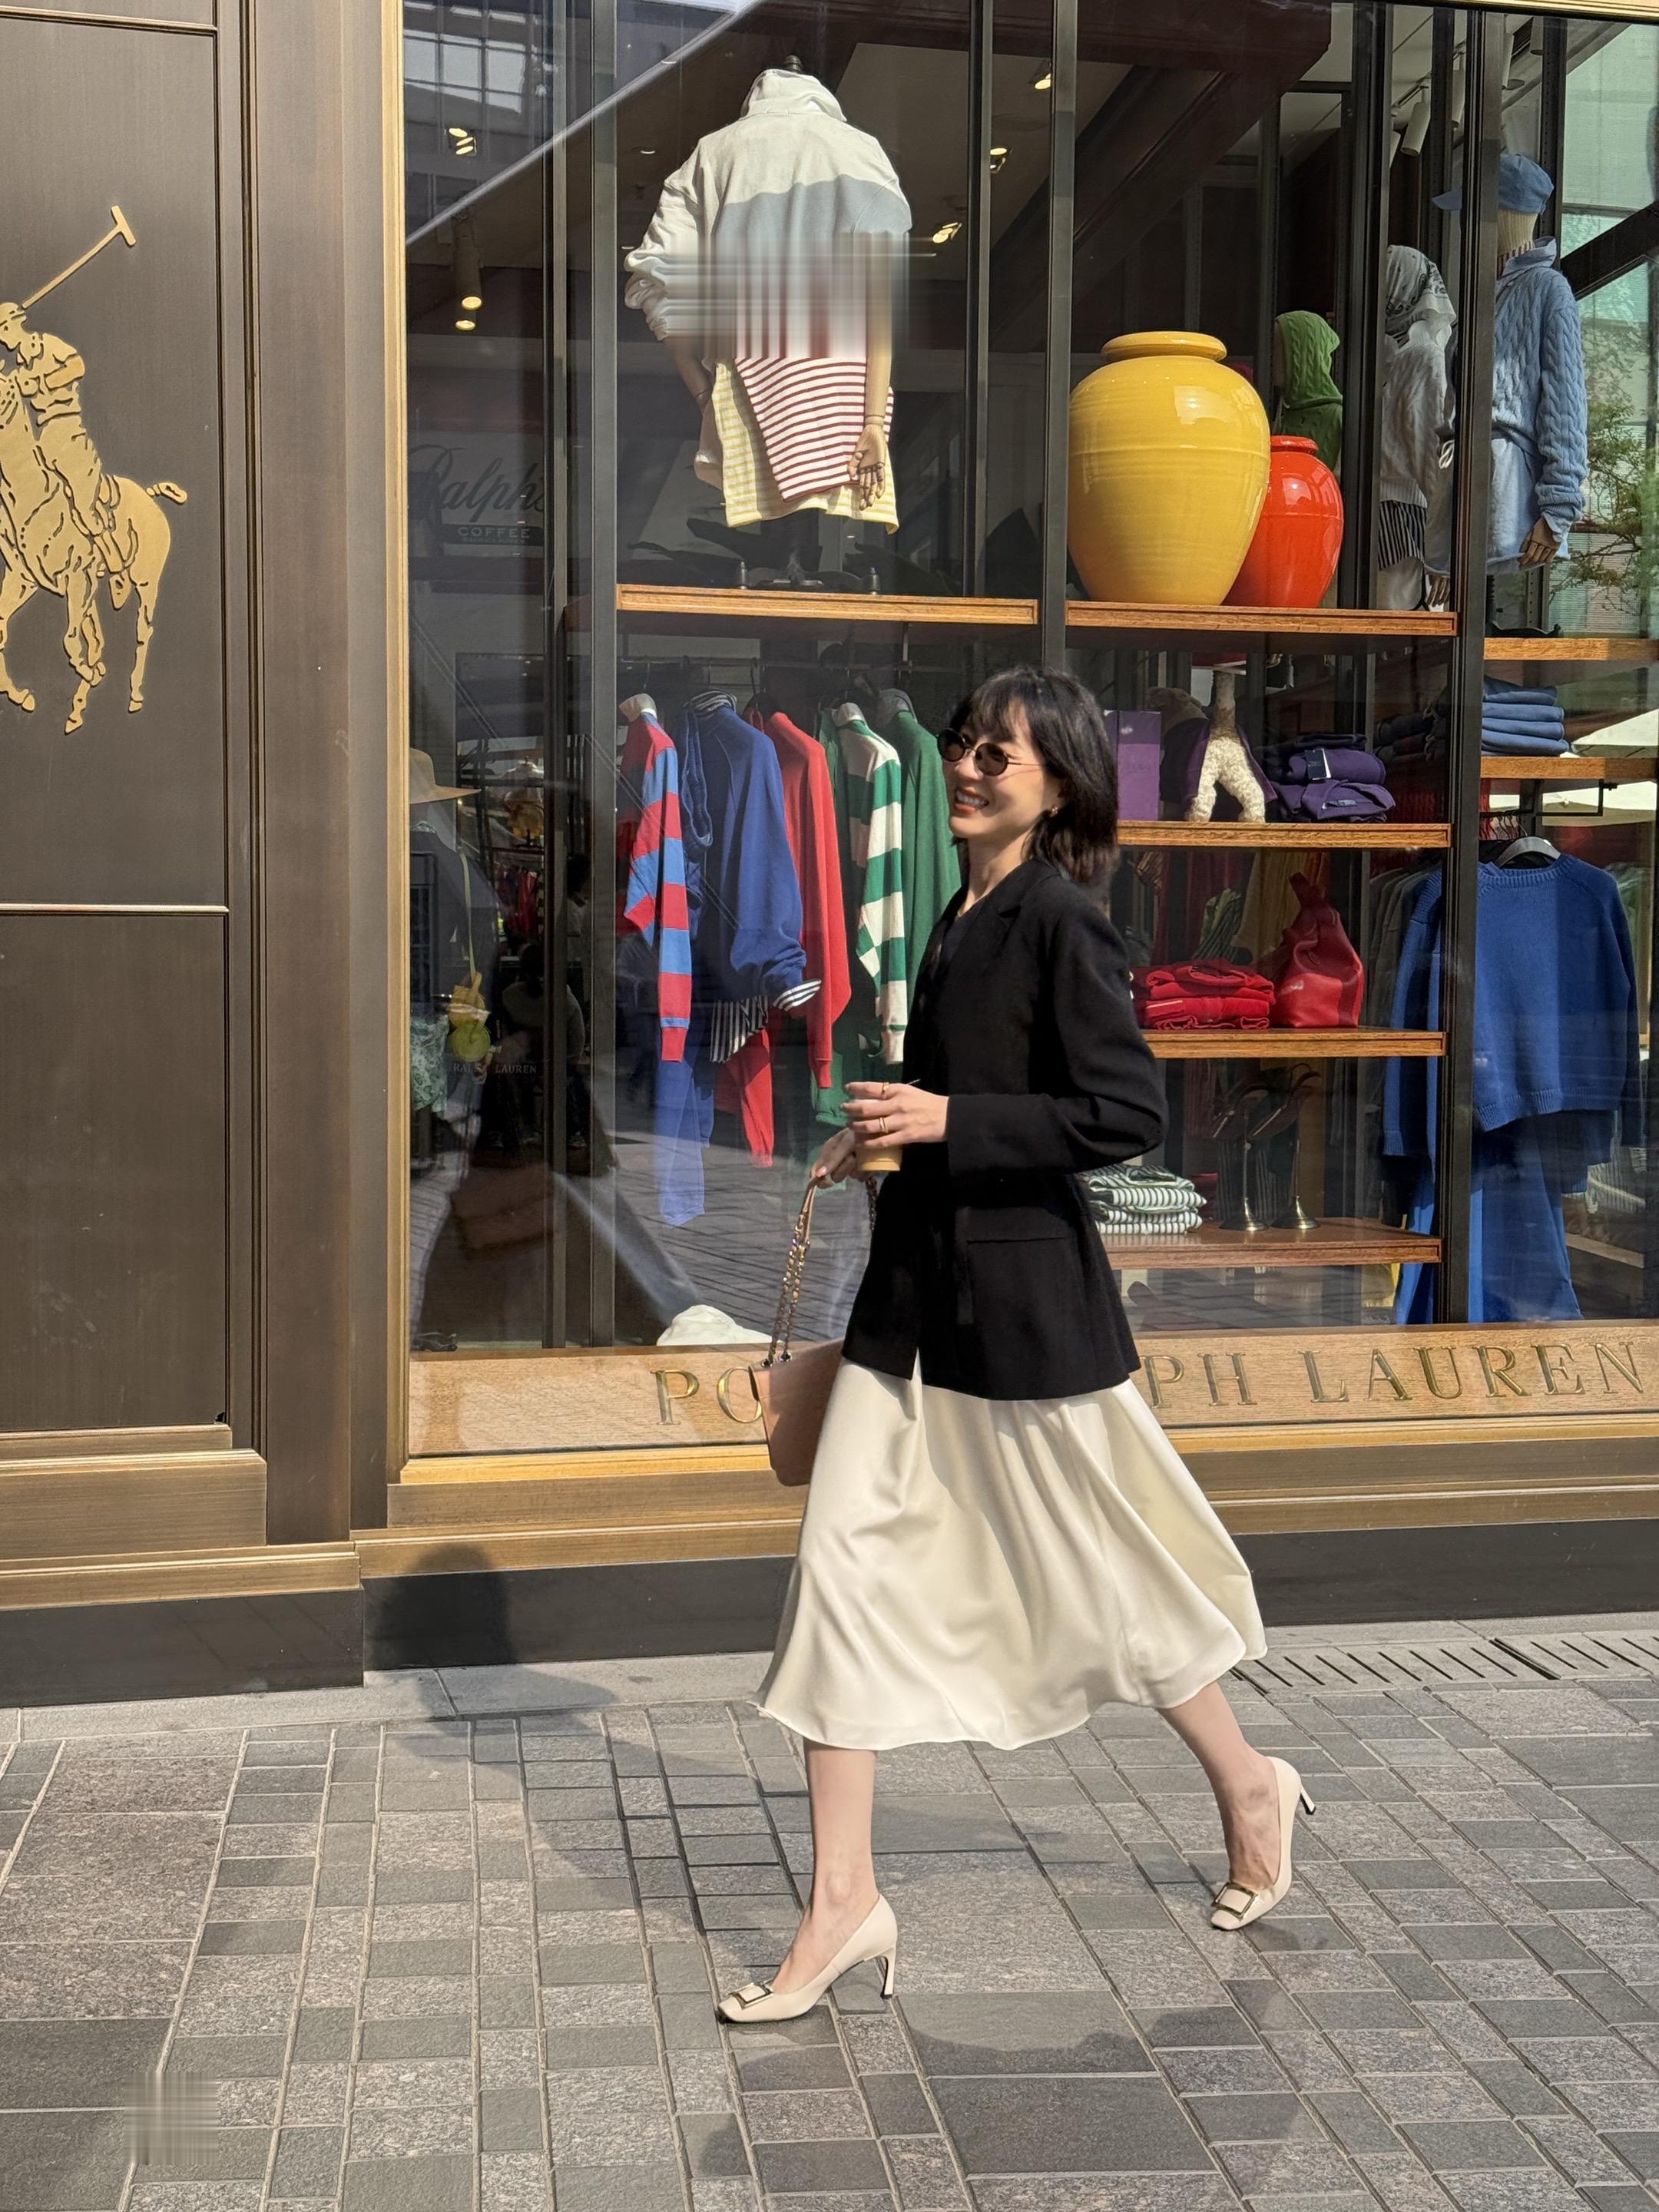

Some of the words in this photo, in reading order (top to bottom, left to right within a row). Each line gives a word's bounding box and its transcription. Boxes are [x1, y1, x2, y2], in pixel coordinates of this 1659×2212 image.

[459, 527, 529, 538] COFFEE
[495, 1064, 537, 1074] LAUREN
[1298, 1341, 1644, 1403] LAUREN
